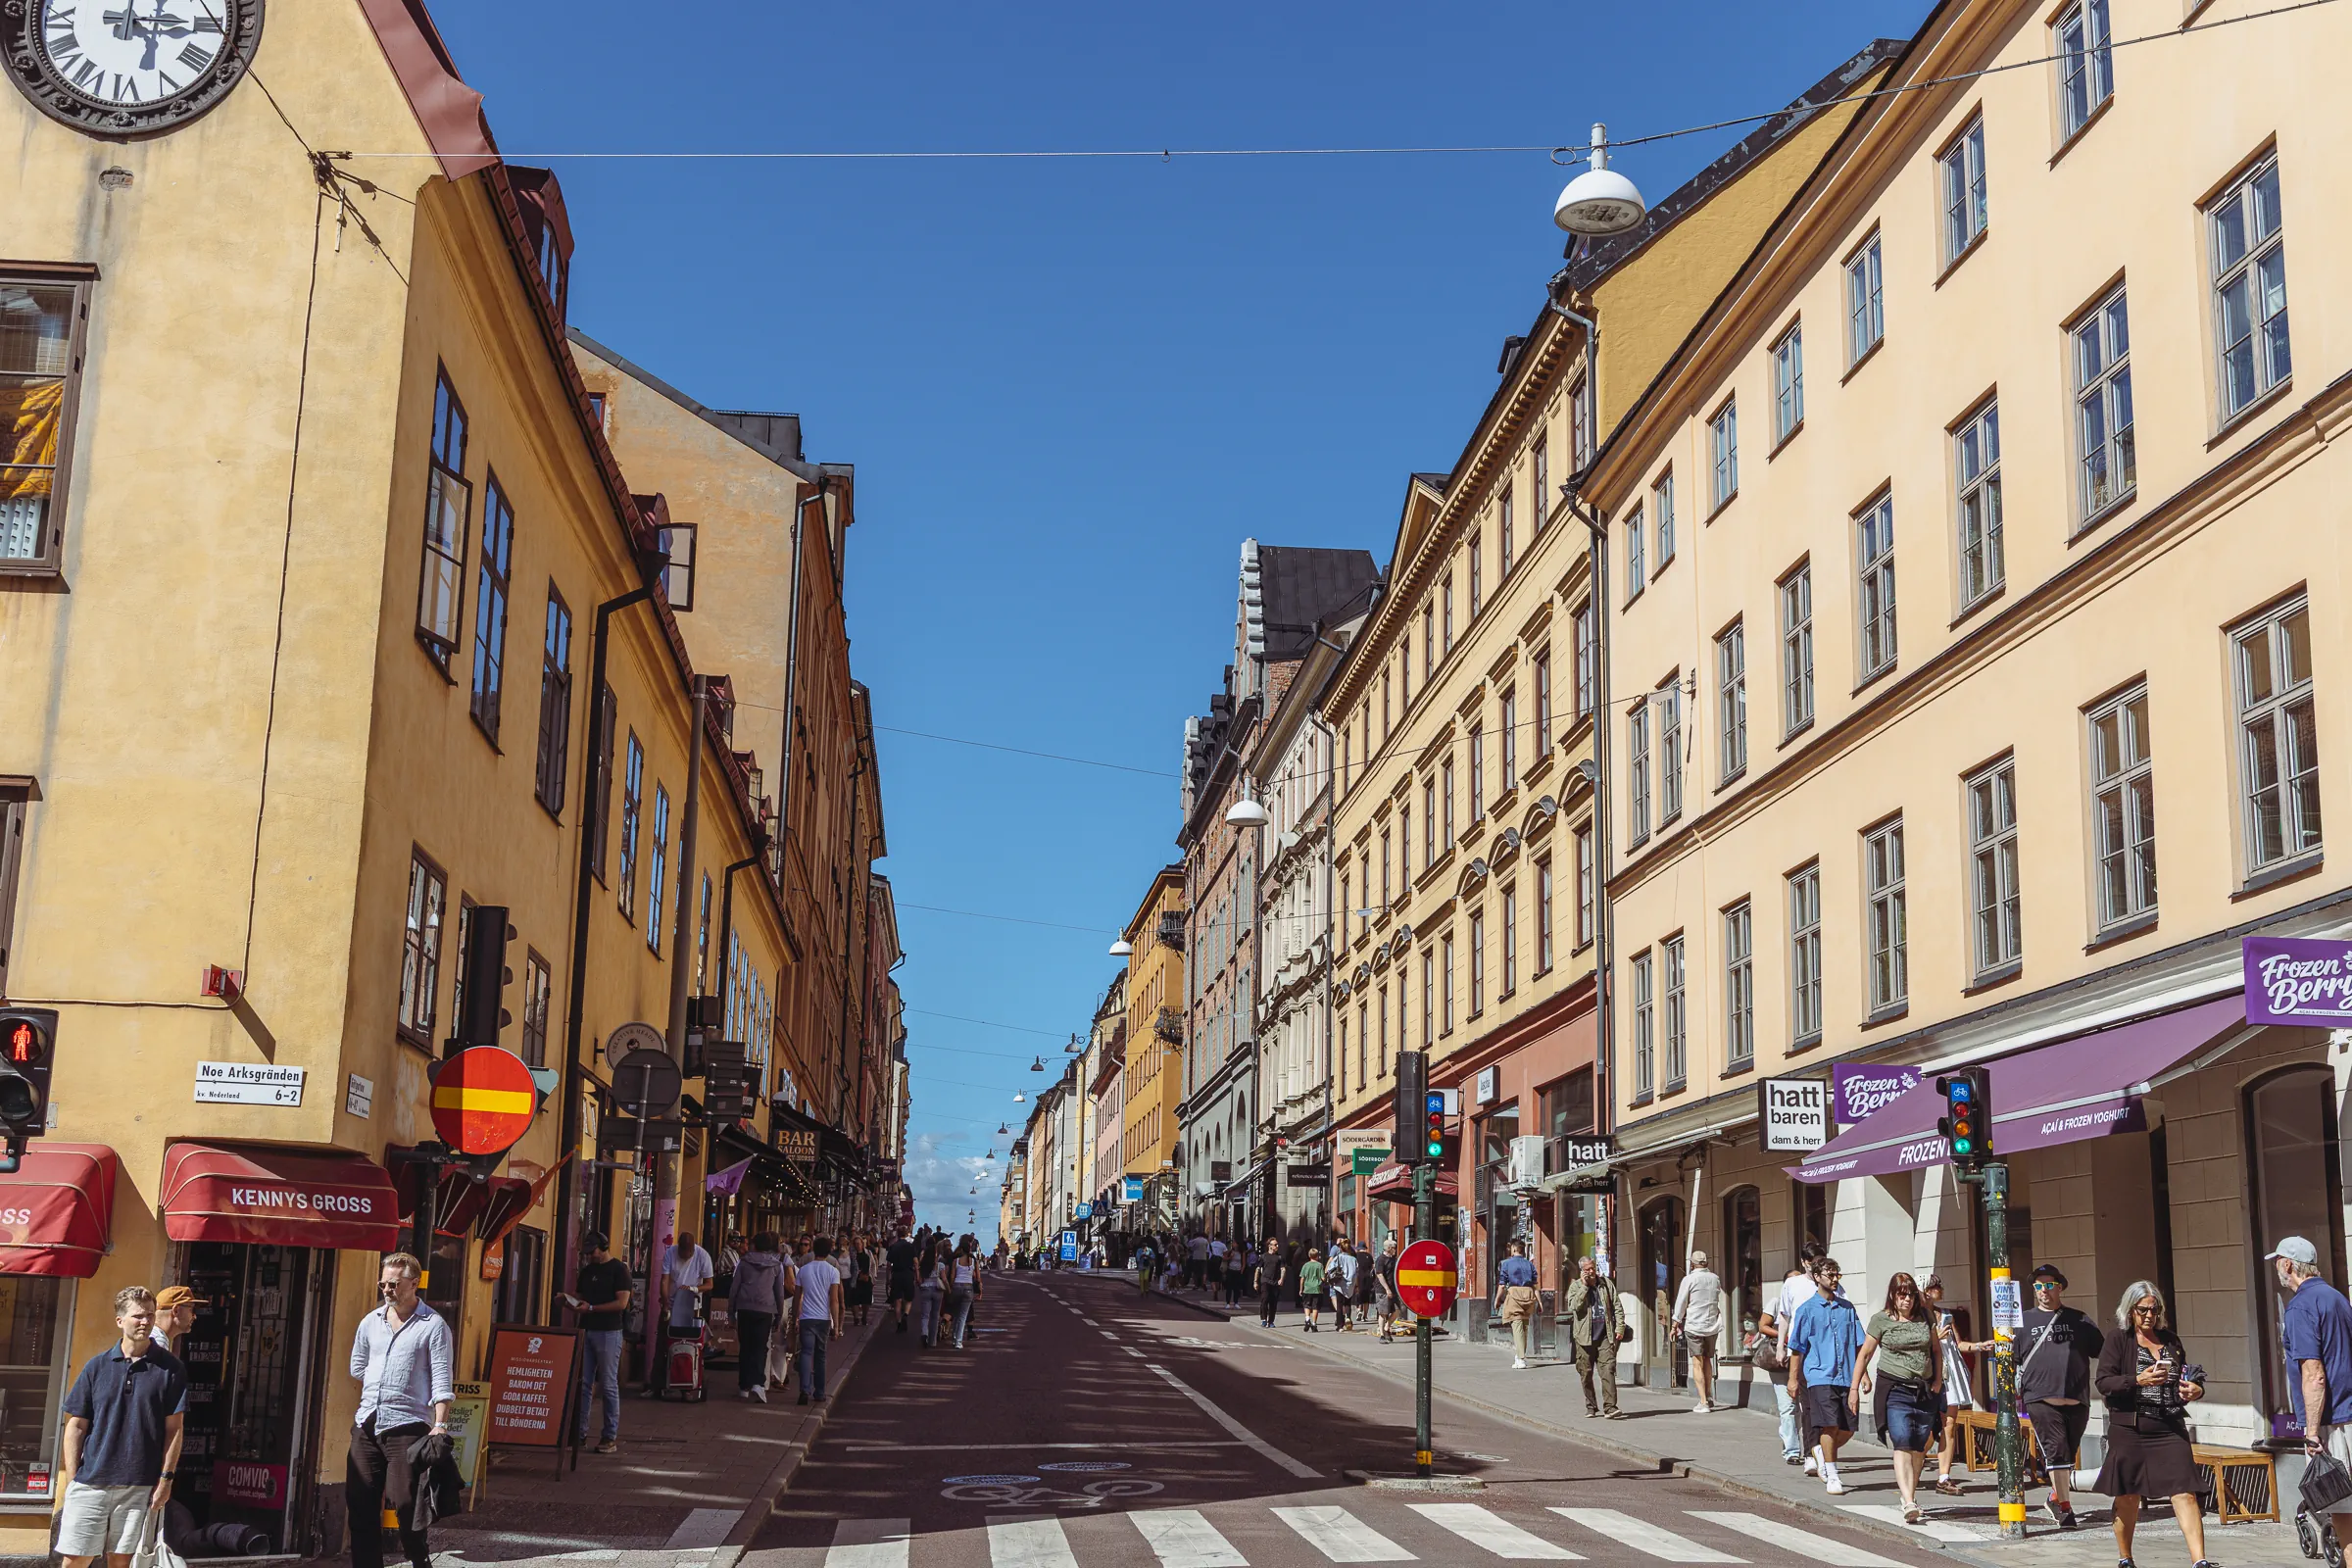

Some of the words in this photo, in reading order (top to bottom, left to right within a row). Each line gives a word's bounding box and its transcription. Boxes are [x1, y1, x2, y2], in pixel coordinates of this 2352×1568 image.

[2258, 954, 2342, 988] Frozen
[202, 1065, 223, 1077] Noe
[228, 1066, 300, 1083] Arksgränden
[1841, 1074, 1899, 1099] Frozen
[209, 1091, 240, 1100] Nederland
[1769, 1084, 1820, 1108] hatt
[1771, 1108, 1821, 1125] baren
[2040, 1118, 2059, 1136] AÇAÍ
[2064, 1113, 2094, 1131] FROZEN
[2093, 1106, 2131, 1124] YOGHURT
[777, 1130, 815, 1147] BAR
[1772, 1135, 1791, 1146] dam
[1793, 1136, 1800, 1146] &
[1802, 1136, 1821, 1146] herr
[777, 1145, 815, 1155] SALOON
[1568, 1140, 1608, 1160] hatt
[1898, 1138, 1946, 1166] FROZEN
[231, 1188, 308, 1209] KENNYS
[312, 1194, 372, 1214] GROSS
[0, 1208, 31, 1225] SS
[1994, 1285, 2015, 1294] VINYL
[507, 1366, 554, 1379] HEMLIGHETEN
[452, 1383, 481, 1396] TRISS
[509, 1380, 533, 1391] BAKOM
[533, 1382, 547, 1391] DET
[502, 1392, 520, 1402] GODA
[521, 1393, 548, 1404] KAFFET:
[449, 1406, 473, 1421] ötsligt
[496, 1403, 526, 1415] DUBBELT
[525, 1405, 550, 1417] BETALT
[495, 1416, 509, 1427] TILL
[509, 1416, 546, 1429] BÖNDERNA
